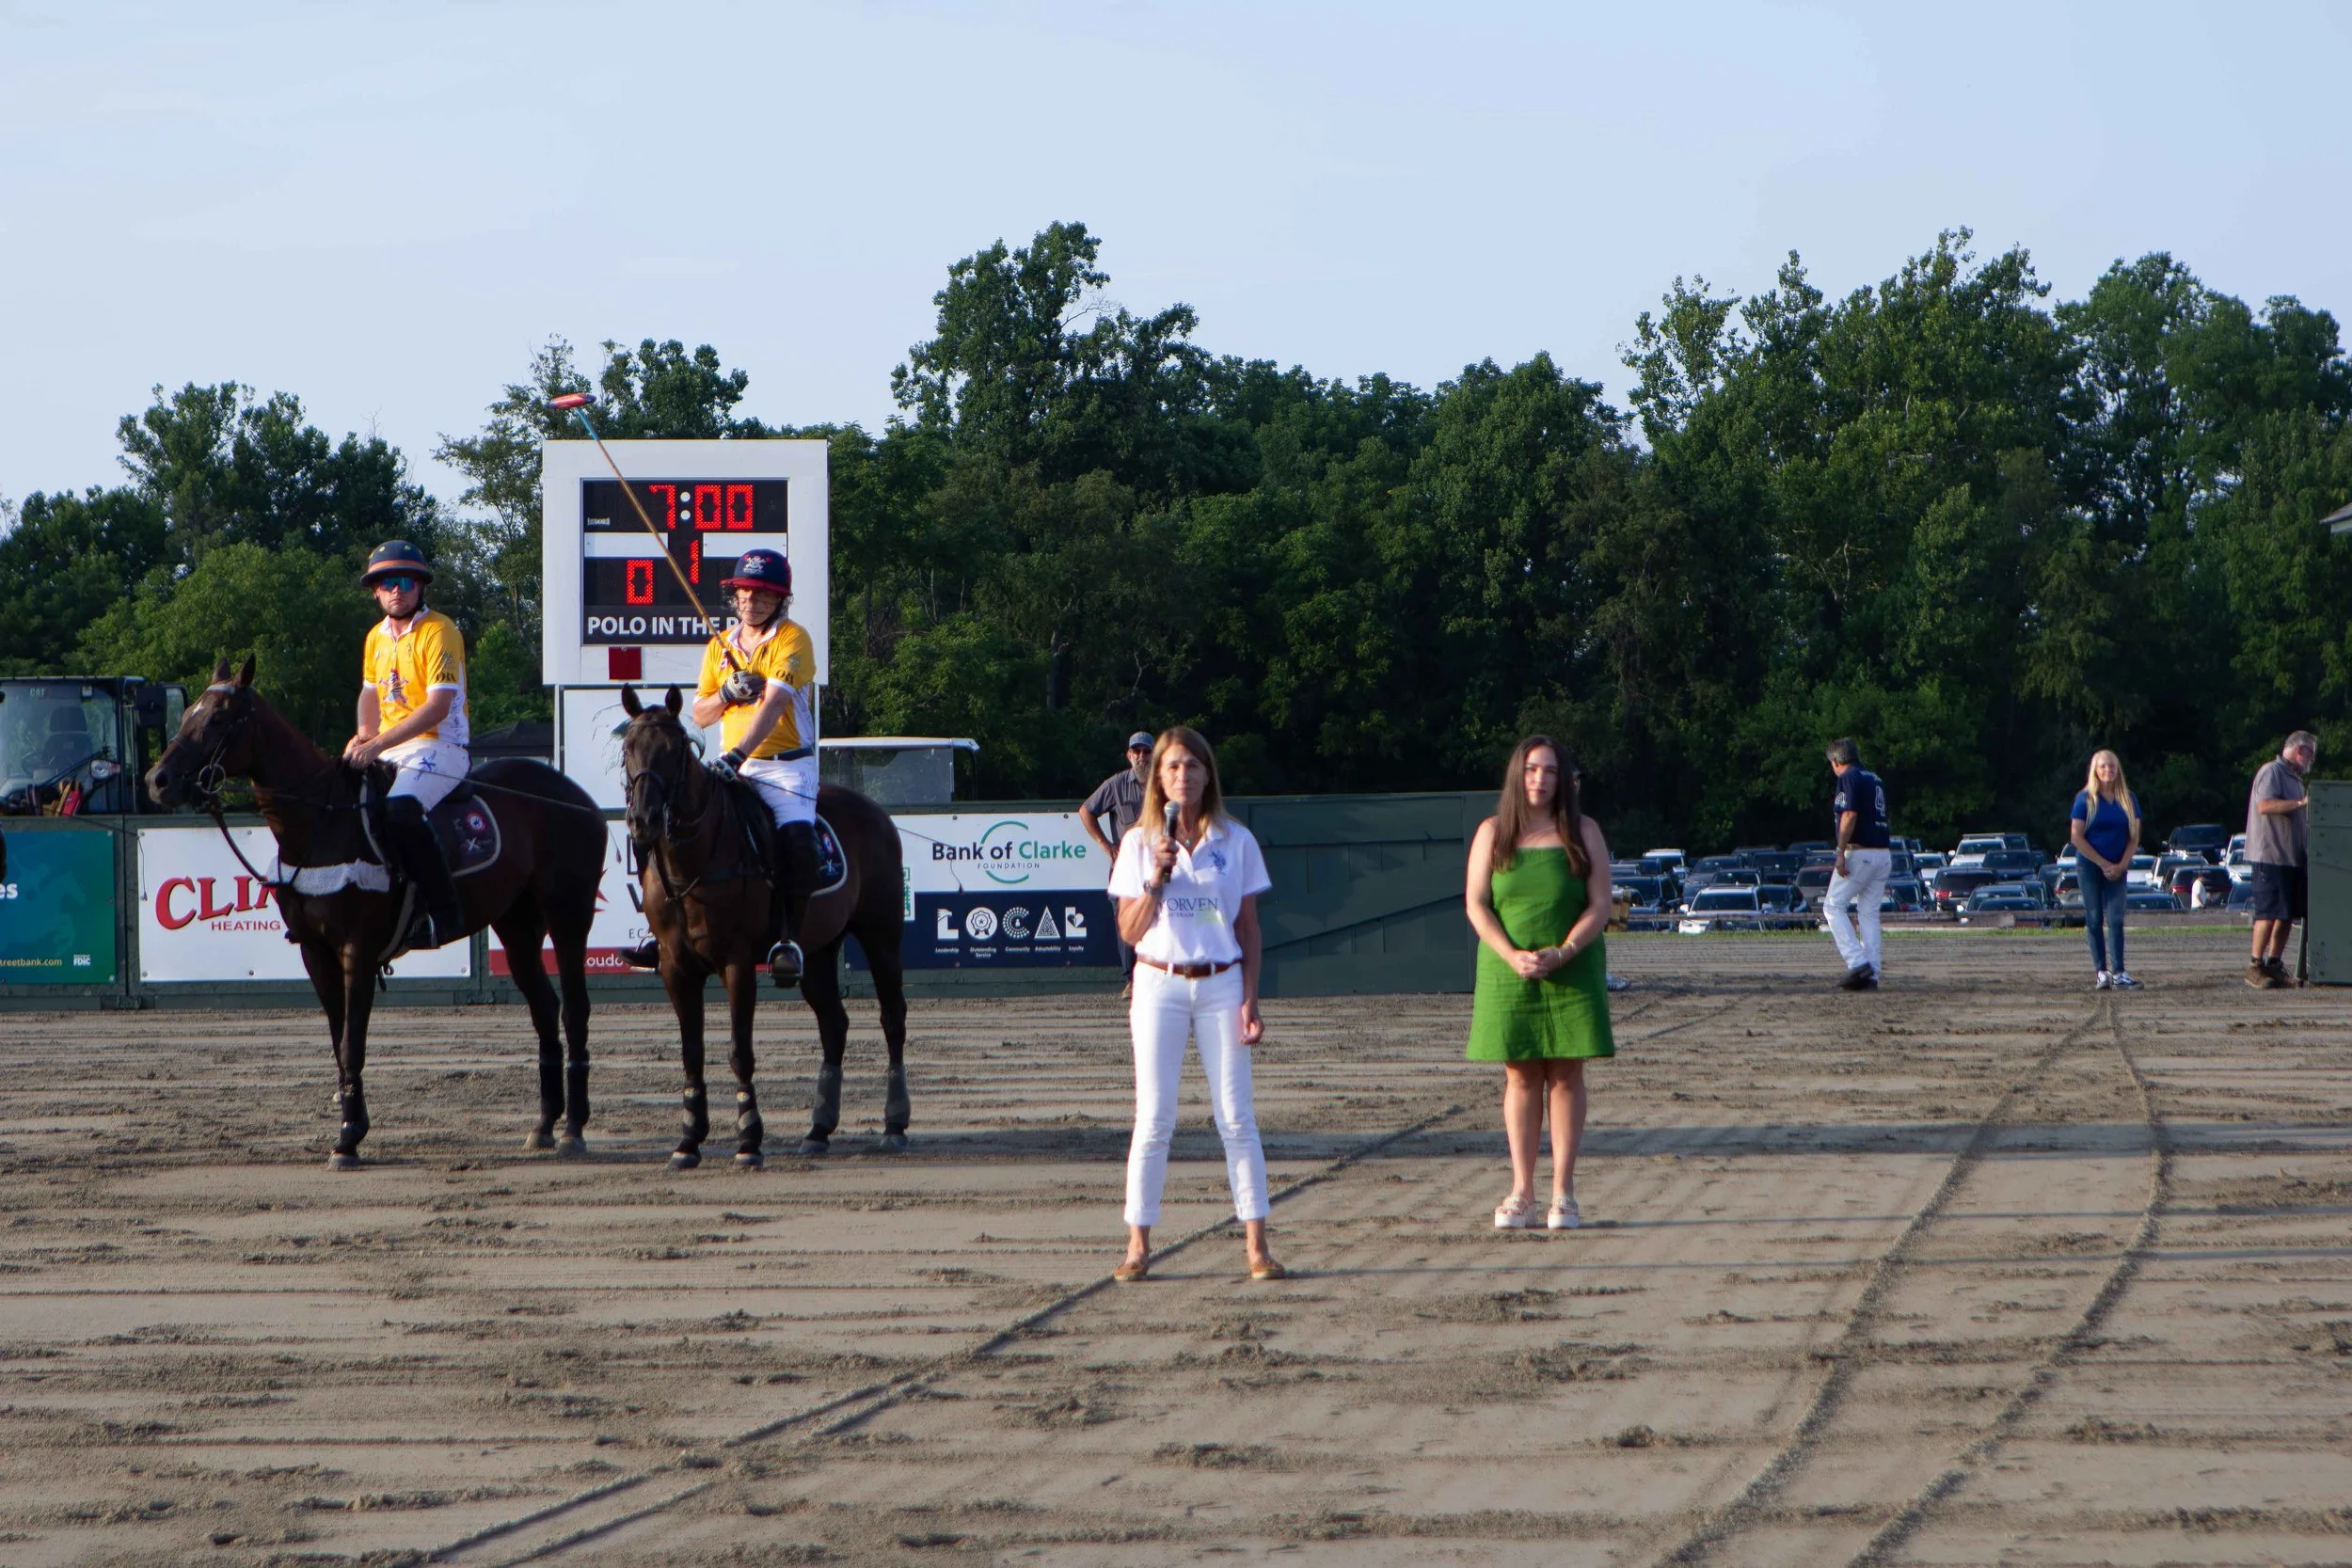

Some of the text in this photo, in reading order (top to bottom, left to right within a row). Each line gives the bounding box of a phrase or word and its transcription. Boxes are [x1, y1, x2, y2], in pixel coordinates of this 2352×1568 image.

[648, 484, 754, 531] 7:00
[627, 559, 654, 605] 0
[587, 616, 646, 636] POLO
[651, 616, 675, 636] IN
[678, 616, 721, 636] THE
[932, 840, 1088, 861] Bank of Clarke
[1160, 897, 1218, 911] ORVEN
[211, 920, 281, 931] HEATING
